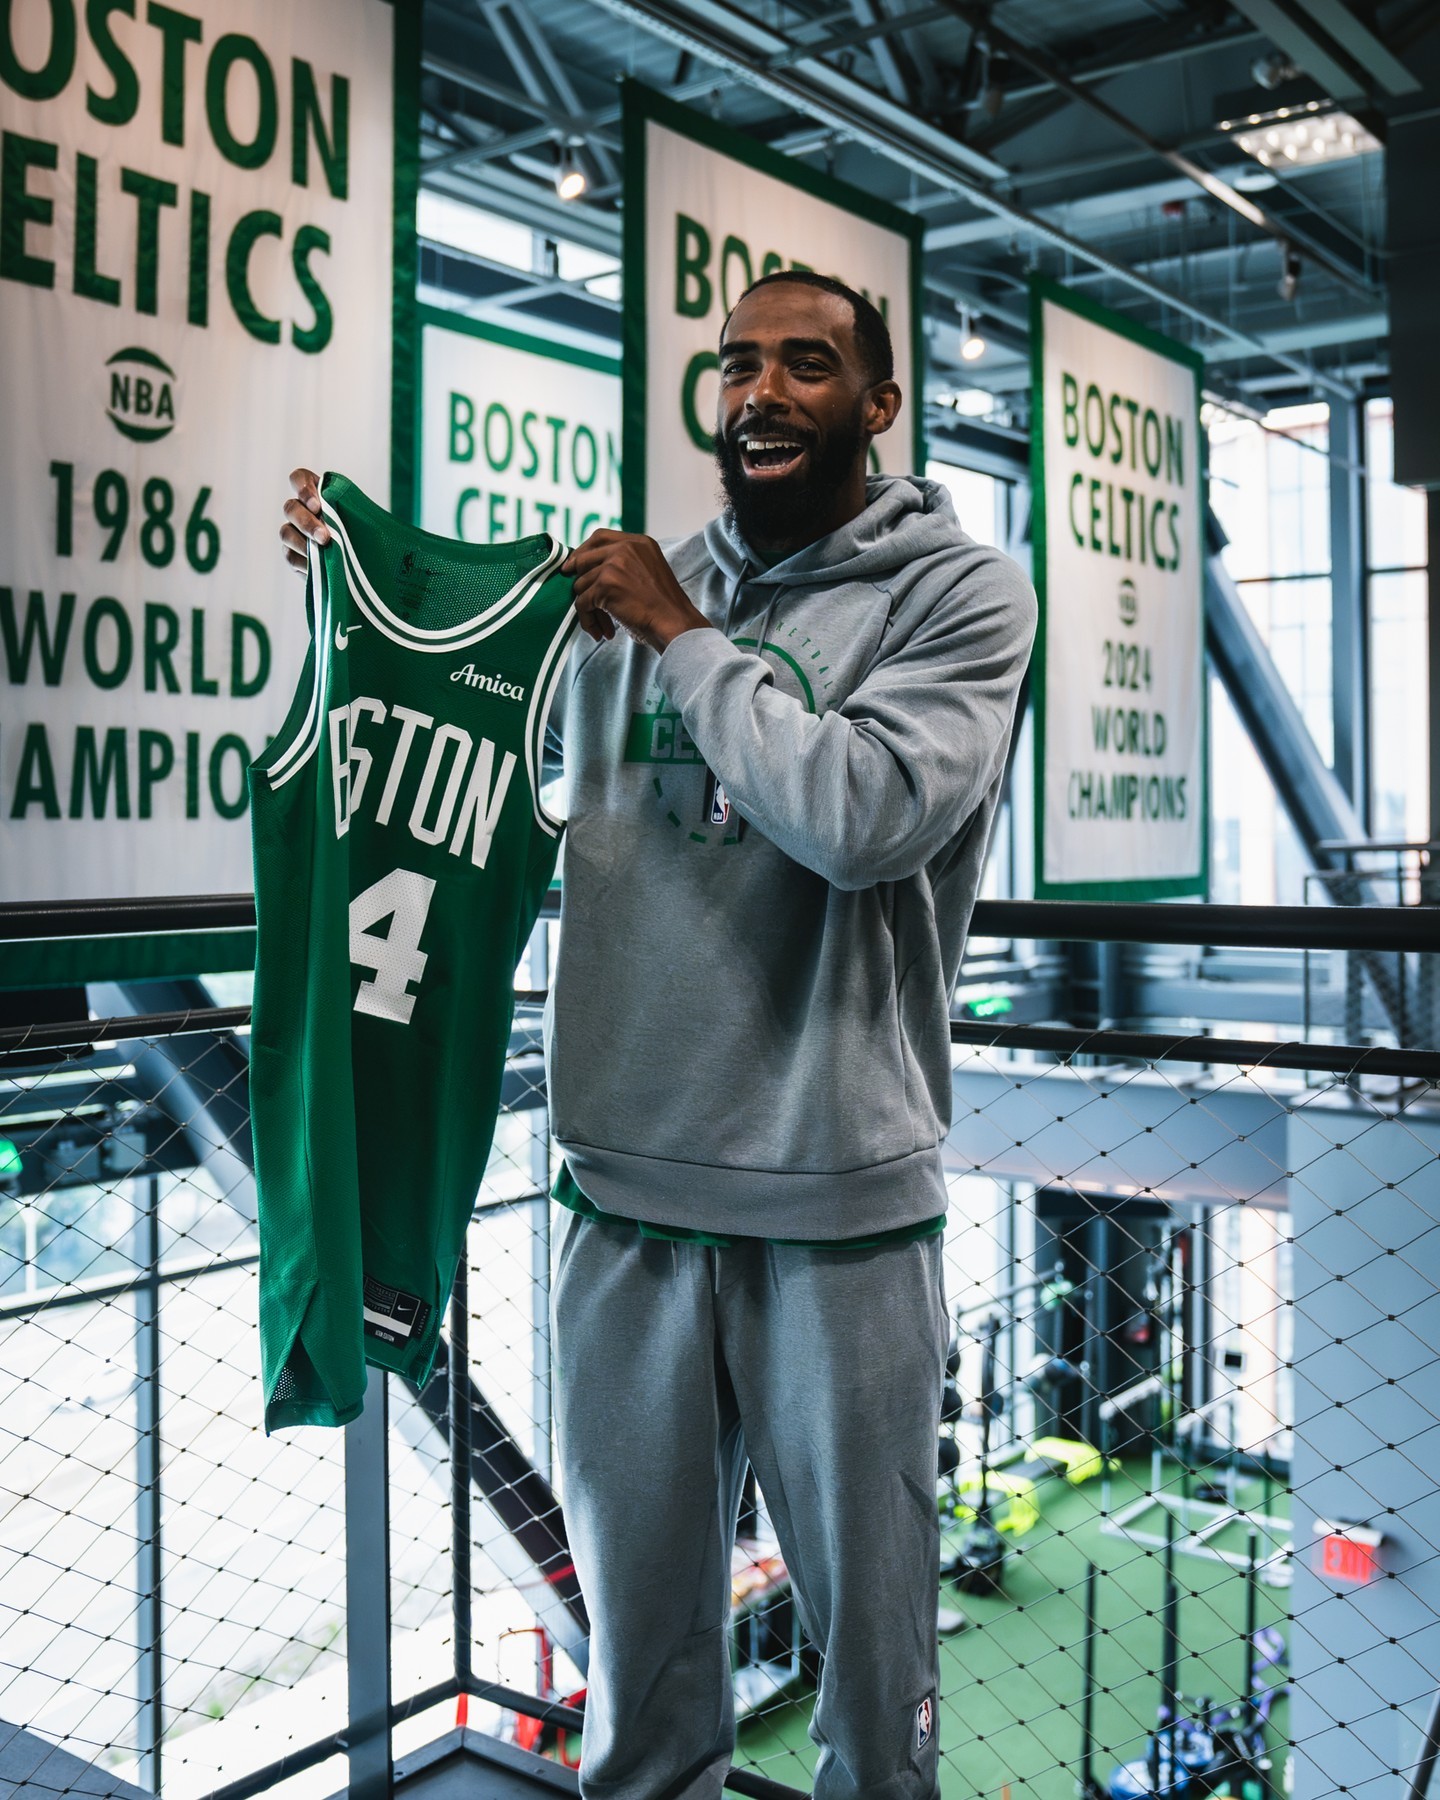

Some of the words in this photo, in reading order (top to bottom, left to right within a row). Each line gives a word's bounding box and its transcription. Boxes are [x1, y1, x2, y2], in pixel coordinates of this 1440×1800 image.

[0, 0, 350, 201] OSTON
[0, 130, 334, 355] ELTICS
[110, 372, 176, 421] NBA
[1062, 372, 1183, 486] BOSTON
[50, 460, 220, 574] 1986
[1069, 473, 1180, 571] CELTICS
[0, 587, 271, 698] WORLD
[450, 663, 525, 701] Amica
[1102, 640, 1152, 692] 2024
[10, 723, 276, 821] AMPIO
[1092, 706, 1167, 757] WORLD
[1068, 772, 1186, 820] CHAMPIONS
[349, 867, 437, 1025] 4
